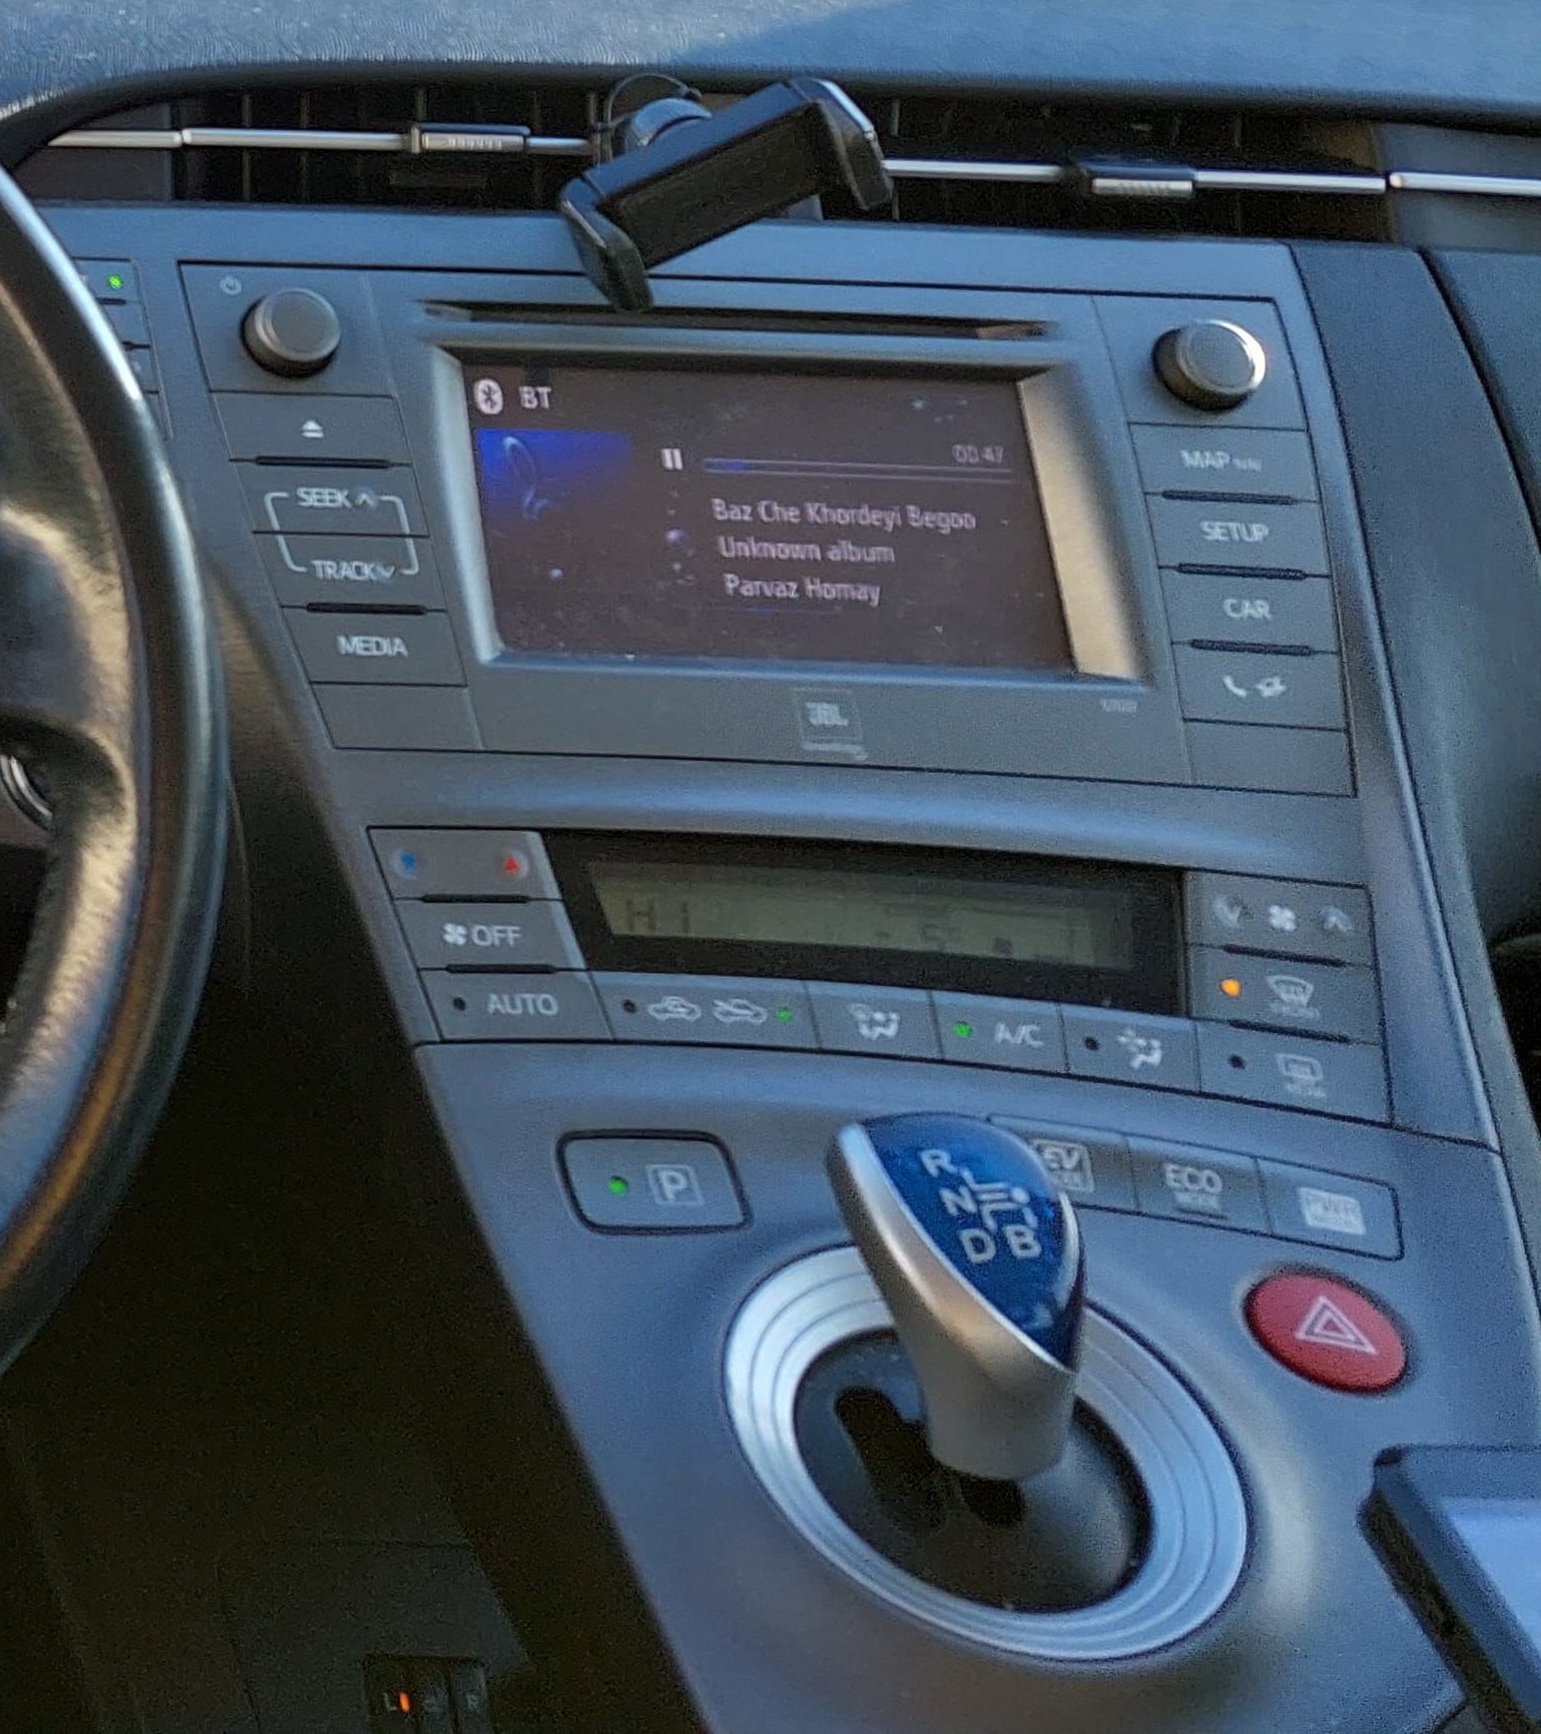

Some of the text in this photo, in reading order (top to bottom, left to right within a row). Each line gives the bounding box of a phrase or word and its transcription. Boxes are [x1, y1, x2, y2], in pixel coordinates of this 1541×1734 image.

[519, 386, 552, 409] BT
[296, 487, 352, 508] SEEK
[712, 503, 754, 522] Baz
[1201, 521, 1269, 542] SETUP
[719, 536, 896, 563] Unknown album
[311, 560, 376, 580] TRACK
[723, 573, 880, 607] Parvaz Homay
[1223, 599, 1271, 619] CAR
[337, 636, 407, 656] MEDIA
[471, 925, 522, 947] OFF
[487, 994, 559, 1016] AUTO
[996, 1022, 1043, 1047] A/C
[920, 1149, 958, 1178] R
[659, 1169, 689, 1203] P
[1165, 1163, 1222, 1193] ECO
[939, 1185, 978, 1217] N
[958, 1227, 997, 1264] D
[1002, 1224, 1042, 1259] B
